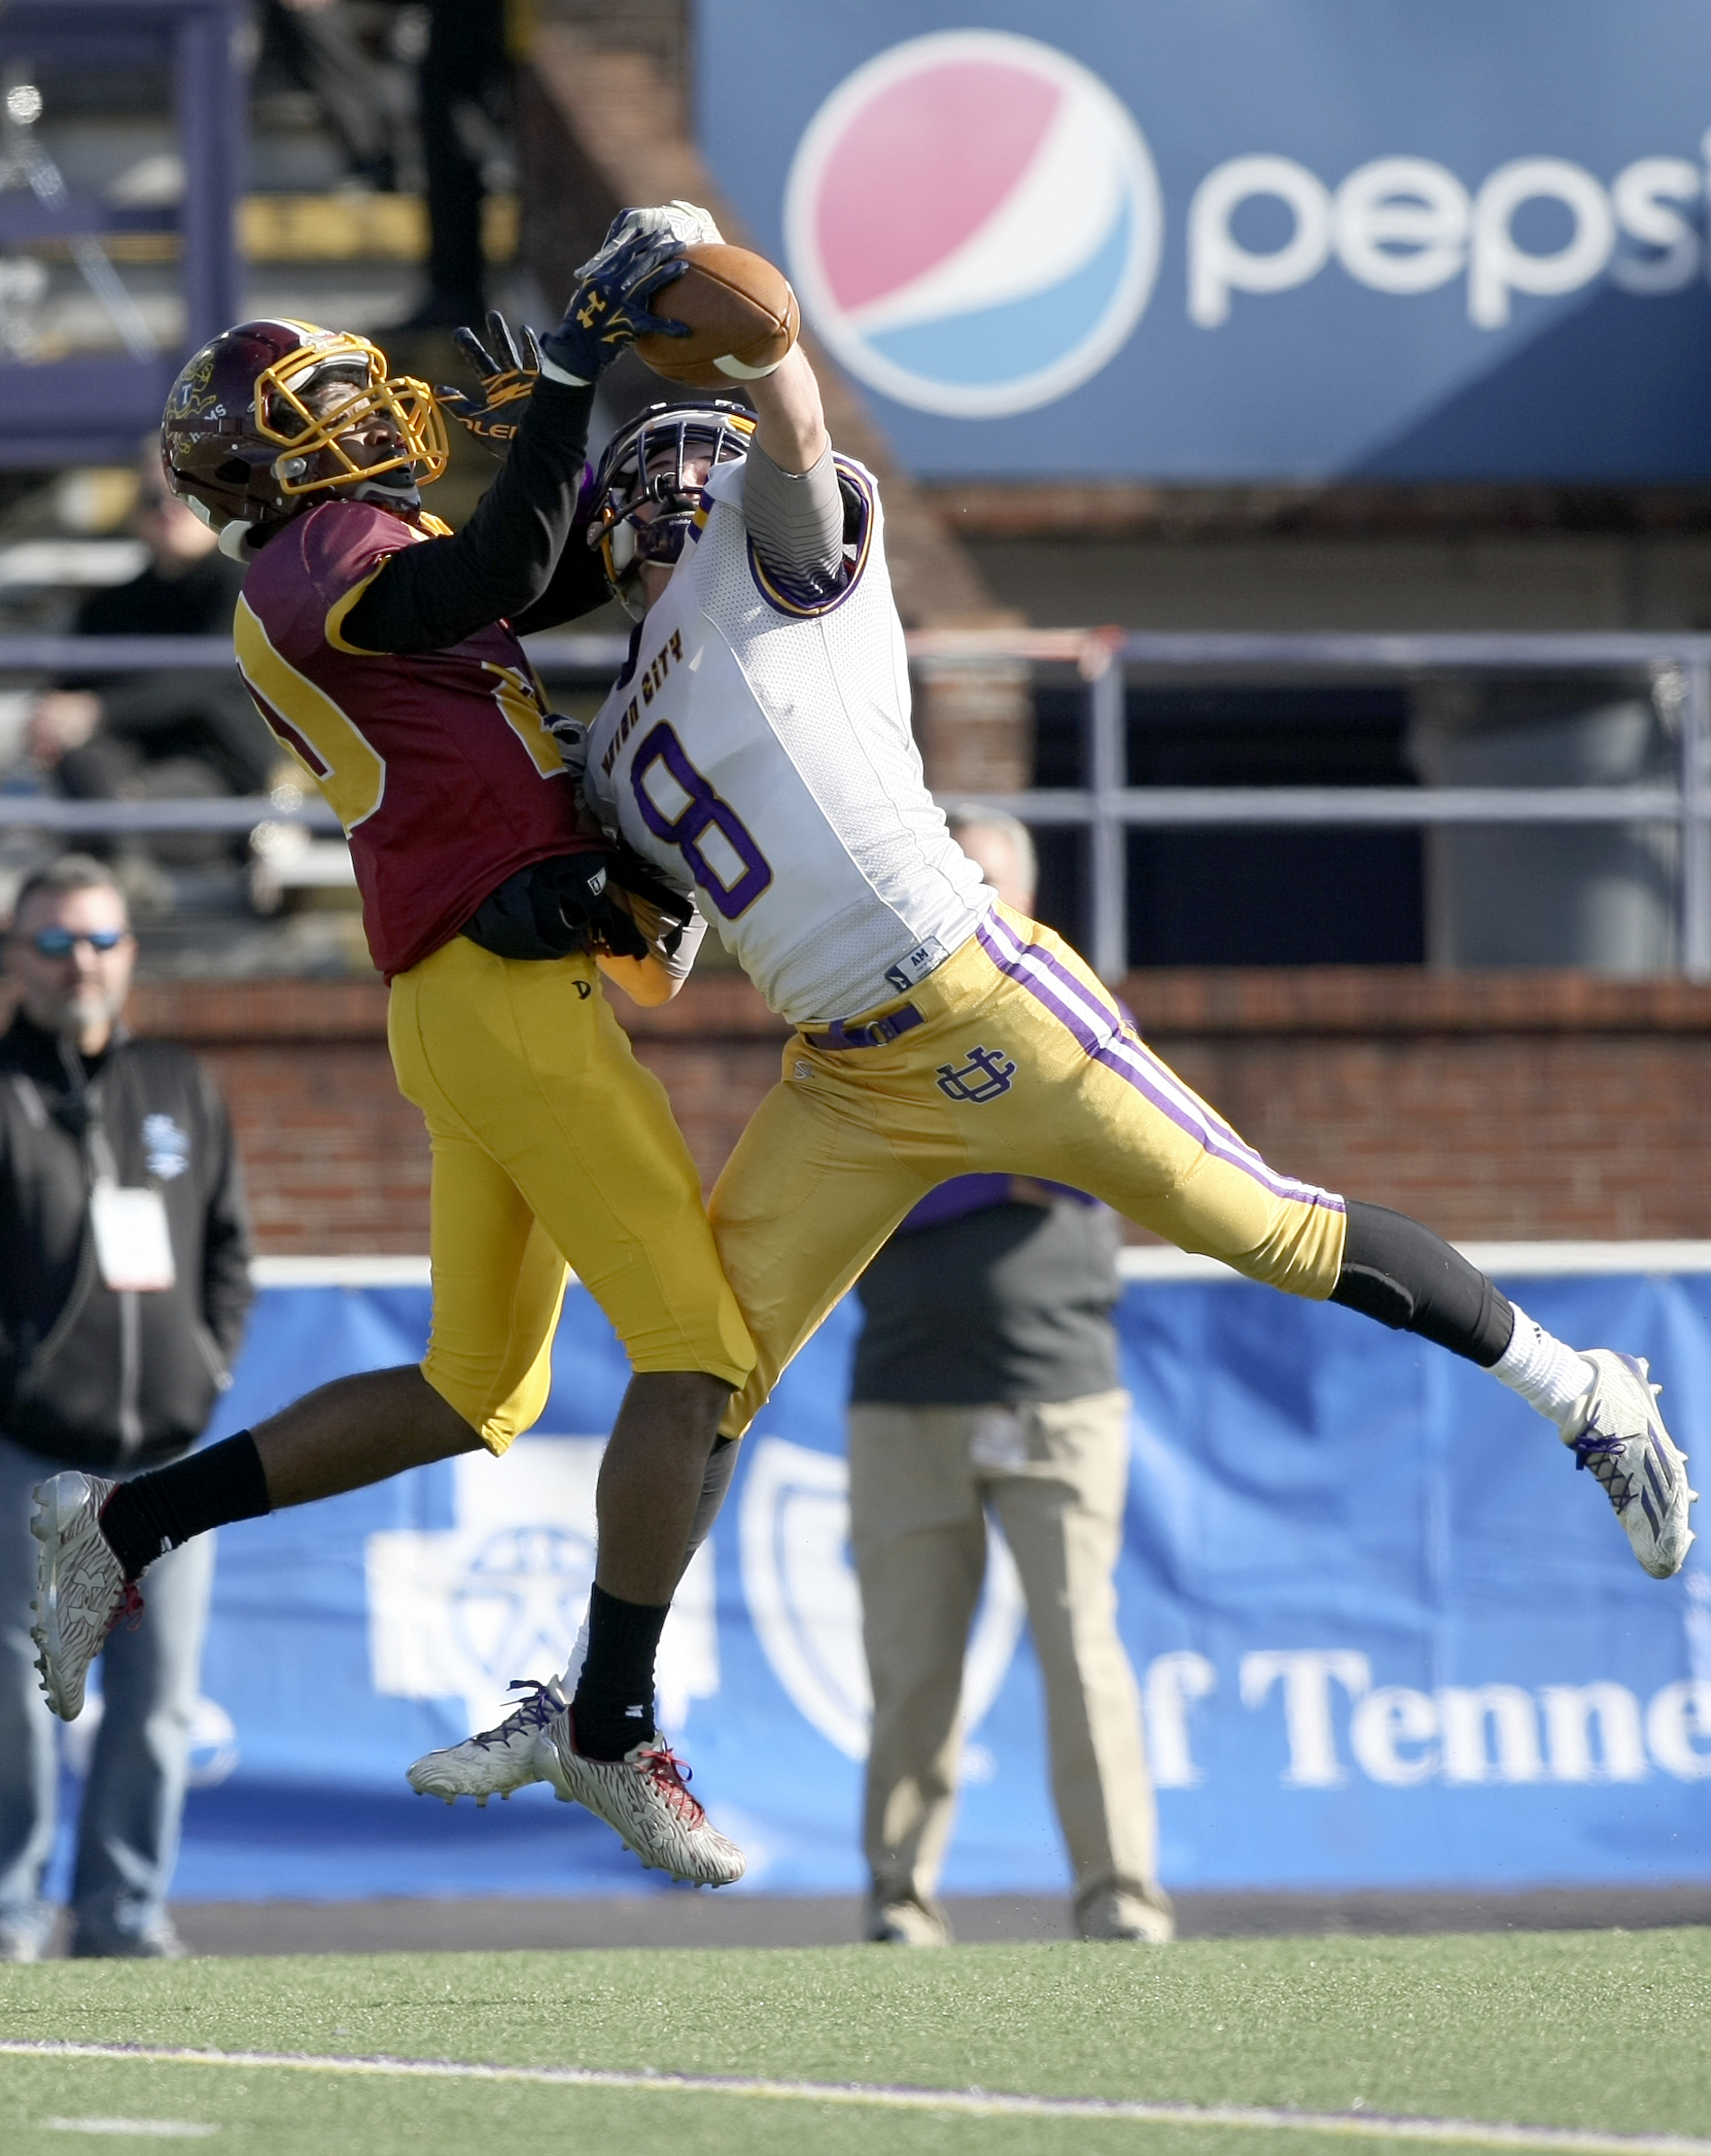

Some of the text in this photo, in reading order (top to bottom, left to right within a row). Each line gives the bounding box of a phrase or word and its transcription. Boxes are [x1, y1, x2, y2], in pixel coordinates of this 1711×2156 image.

[641, 628, 684, 707] CITY
[631, 719, 773, 923] 8
[911, 948, 929, 967] AM
[1143, 1648, 1711, 1788] f Tenne
